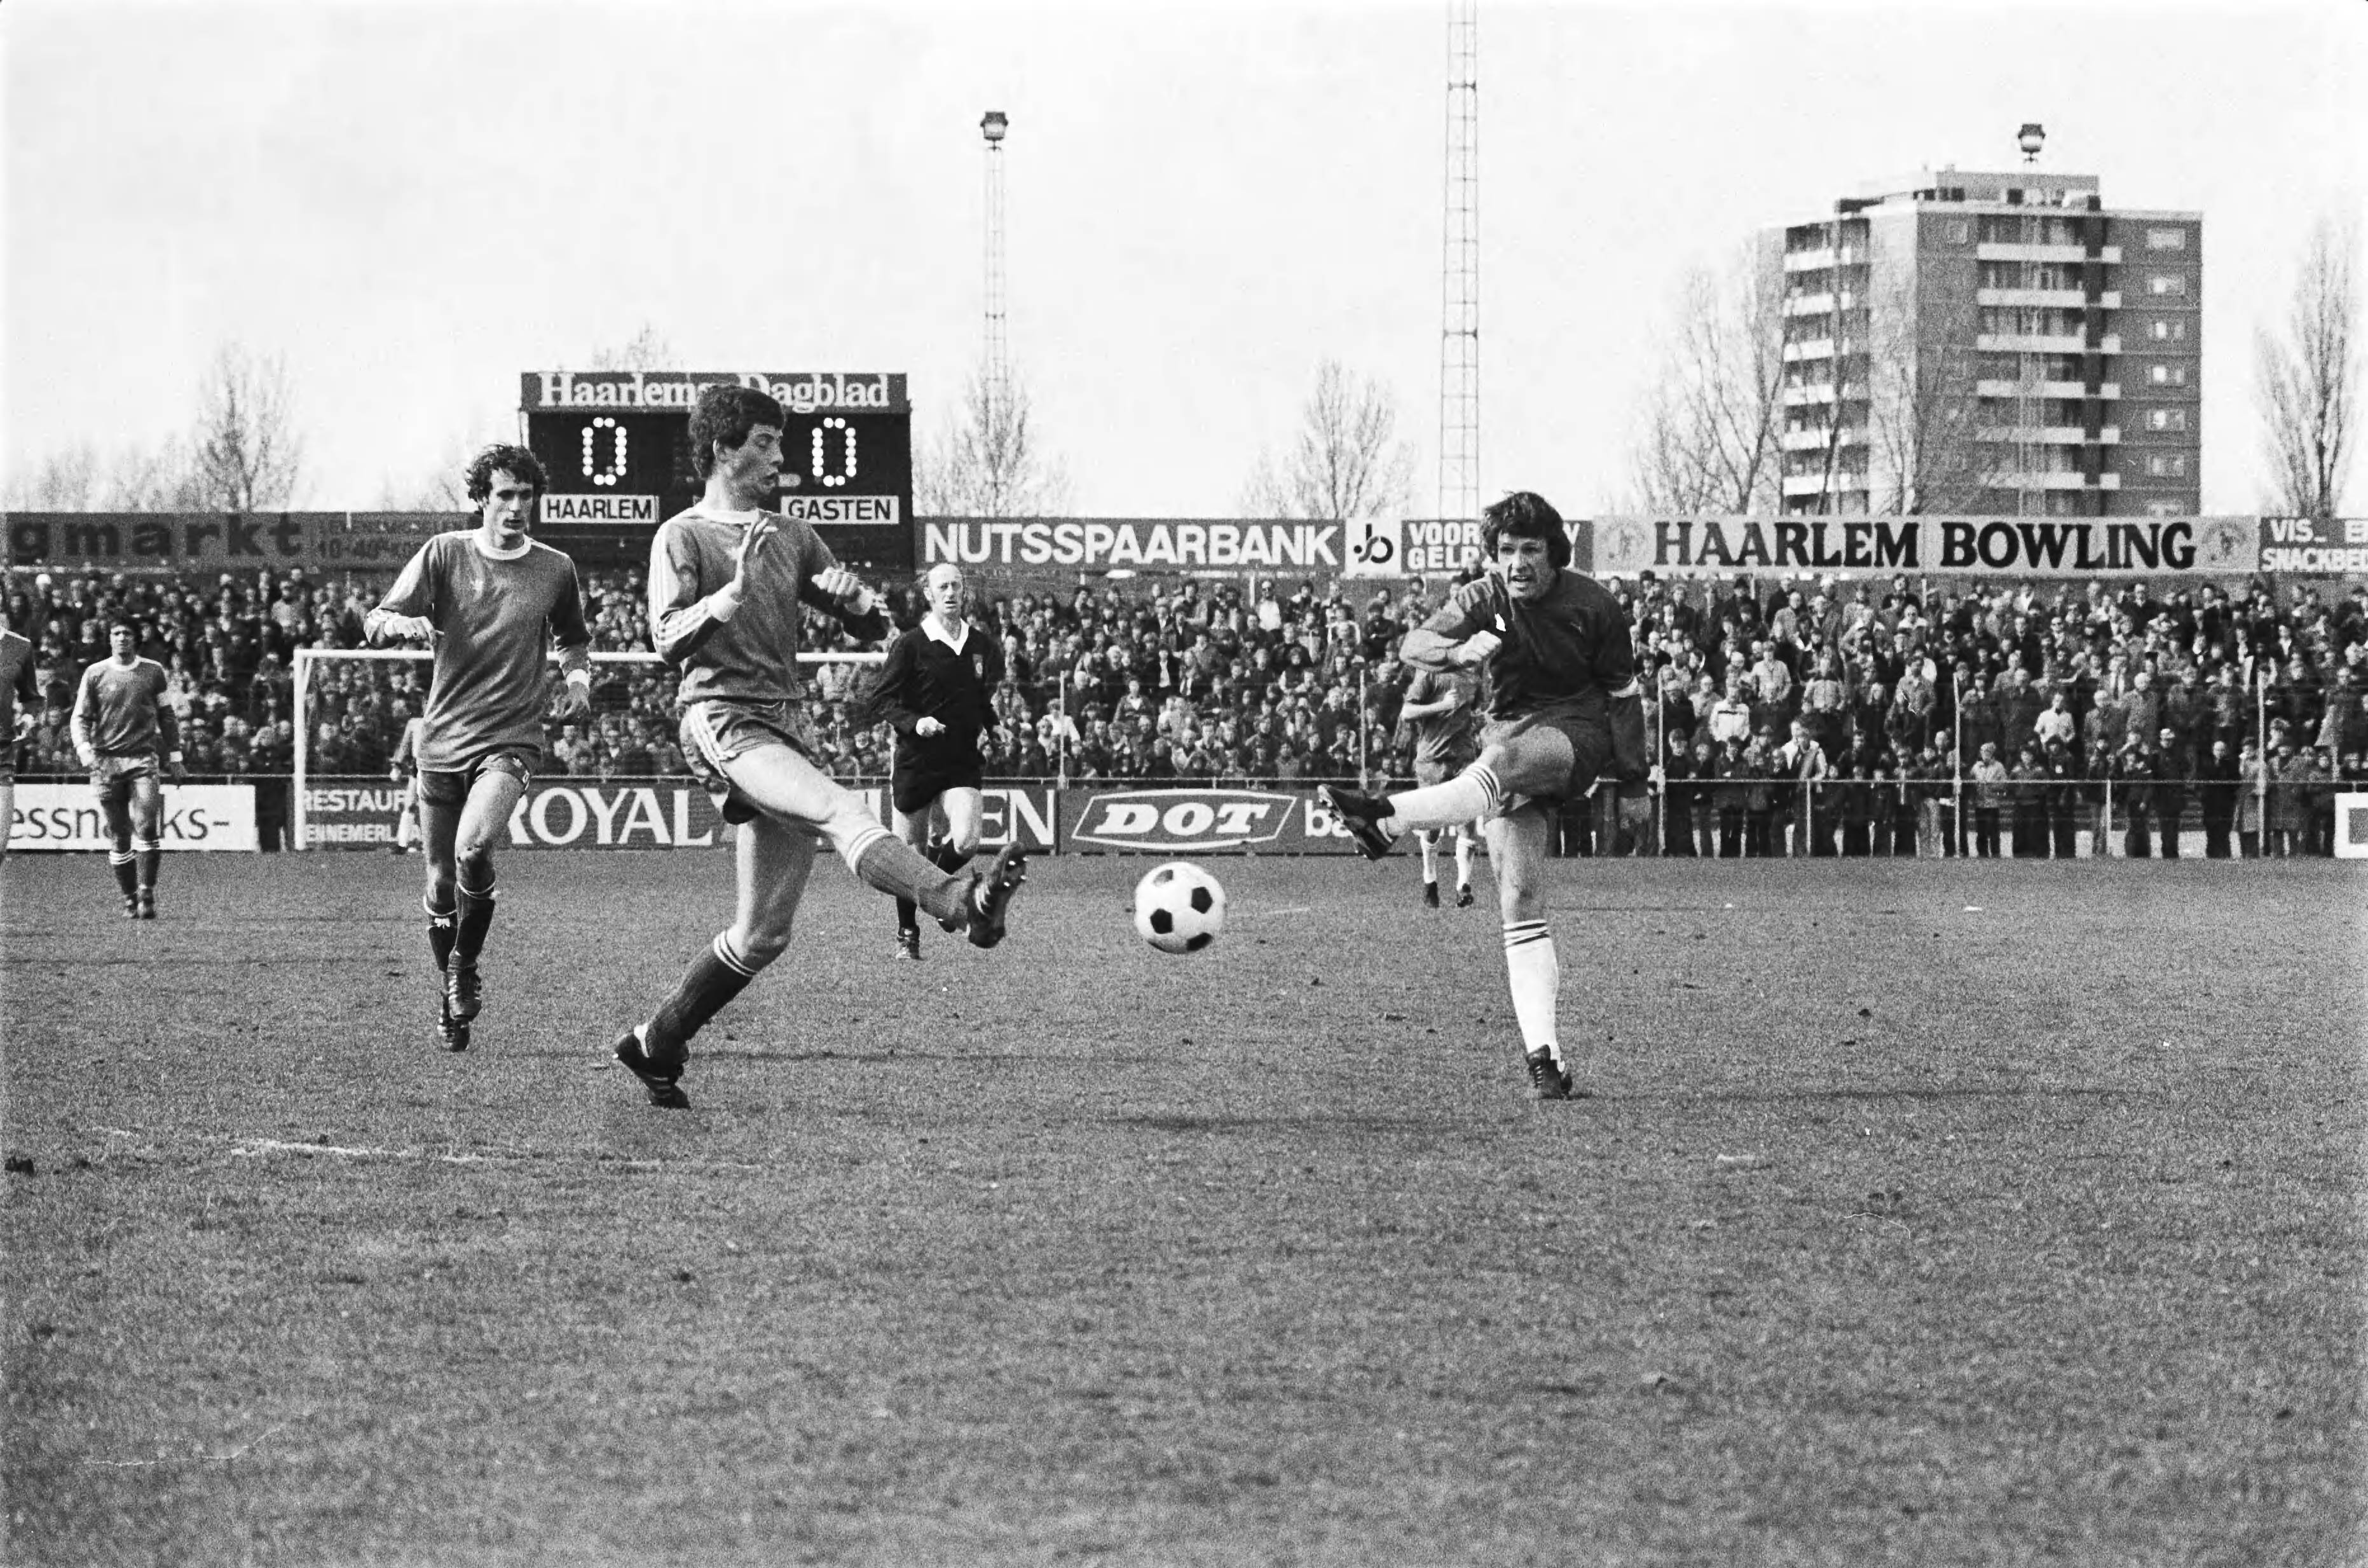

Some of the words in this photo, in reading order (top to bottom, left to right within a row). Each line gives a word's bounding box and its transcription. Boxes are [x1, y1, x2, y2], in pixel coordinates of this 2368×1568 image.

[737, 373, 889, 413] Dagblad
[582, 417, 627, 486] 0
[811, 417, 856, 487] 0
[546, 499, 652, 520] HAARLEM
[789, 500, 891, 521] GASTEN
[10, 514, 303, 564] gmarkt
[925, 523, 1338, 565] NUTSSPAARBANK
[1654, 522, 1919, 568] HAARLEM
[1940, 522, 2196, 569] BOWLING
[303, 789, 408, 811] RESTAUR
[1094, 802, 1270, 835] DOT
